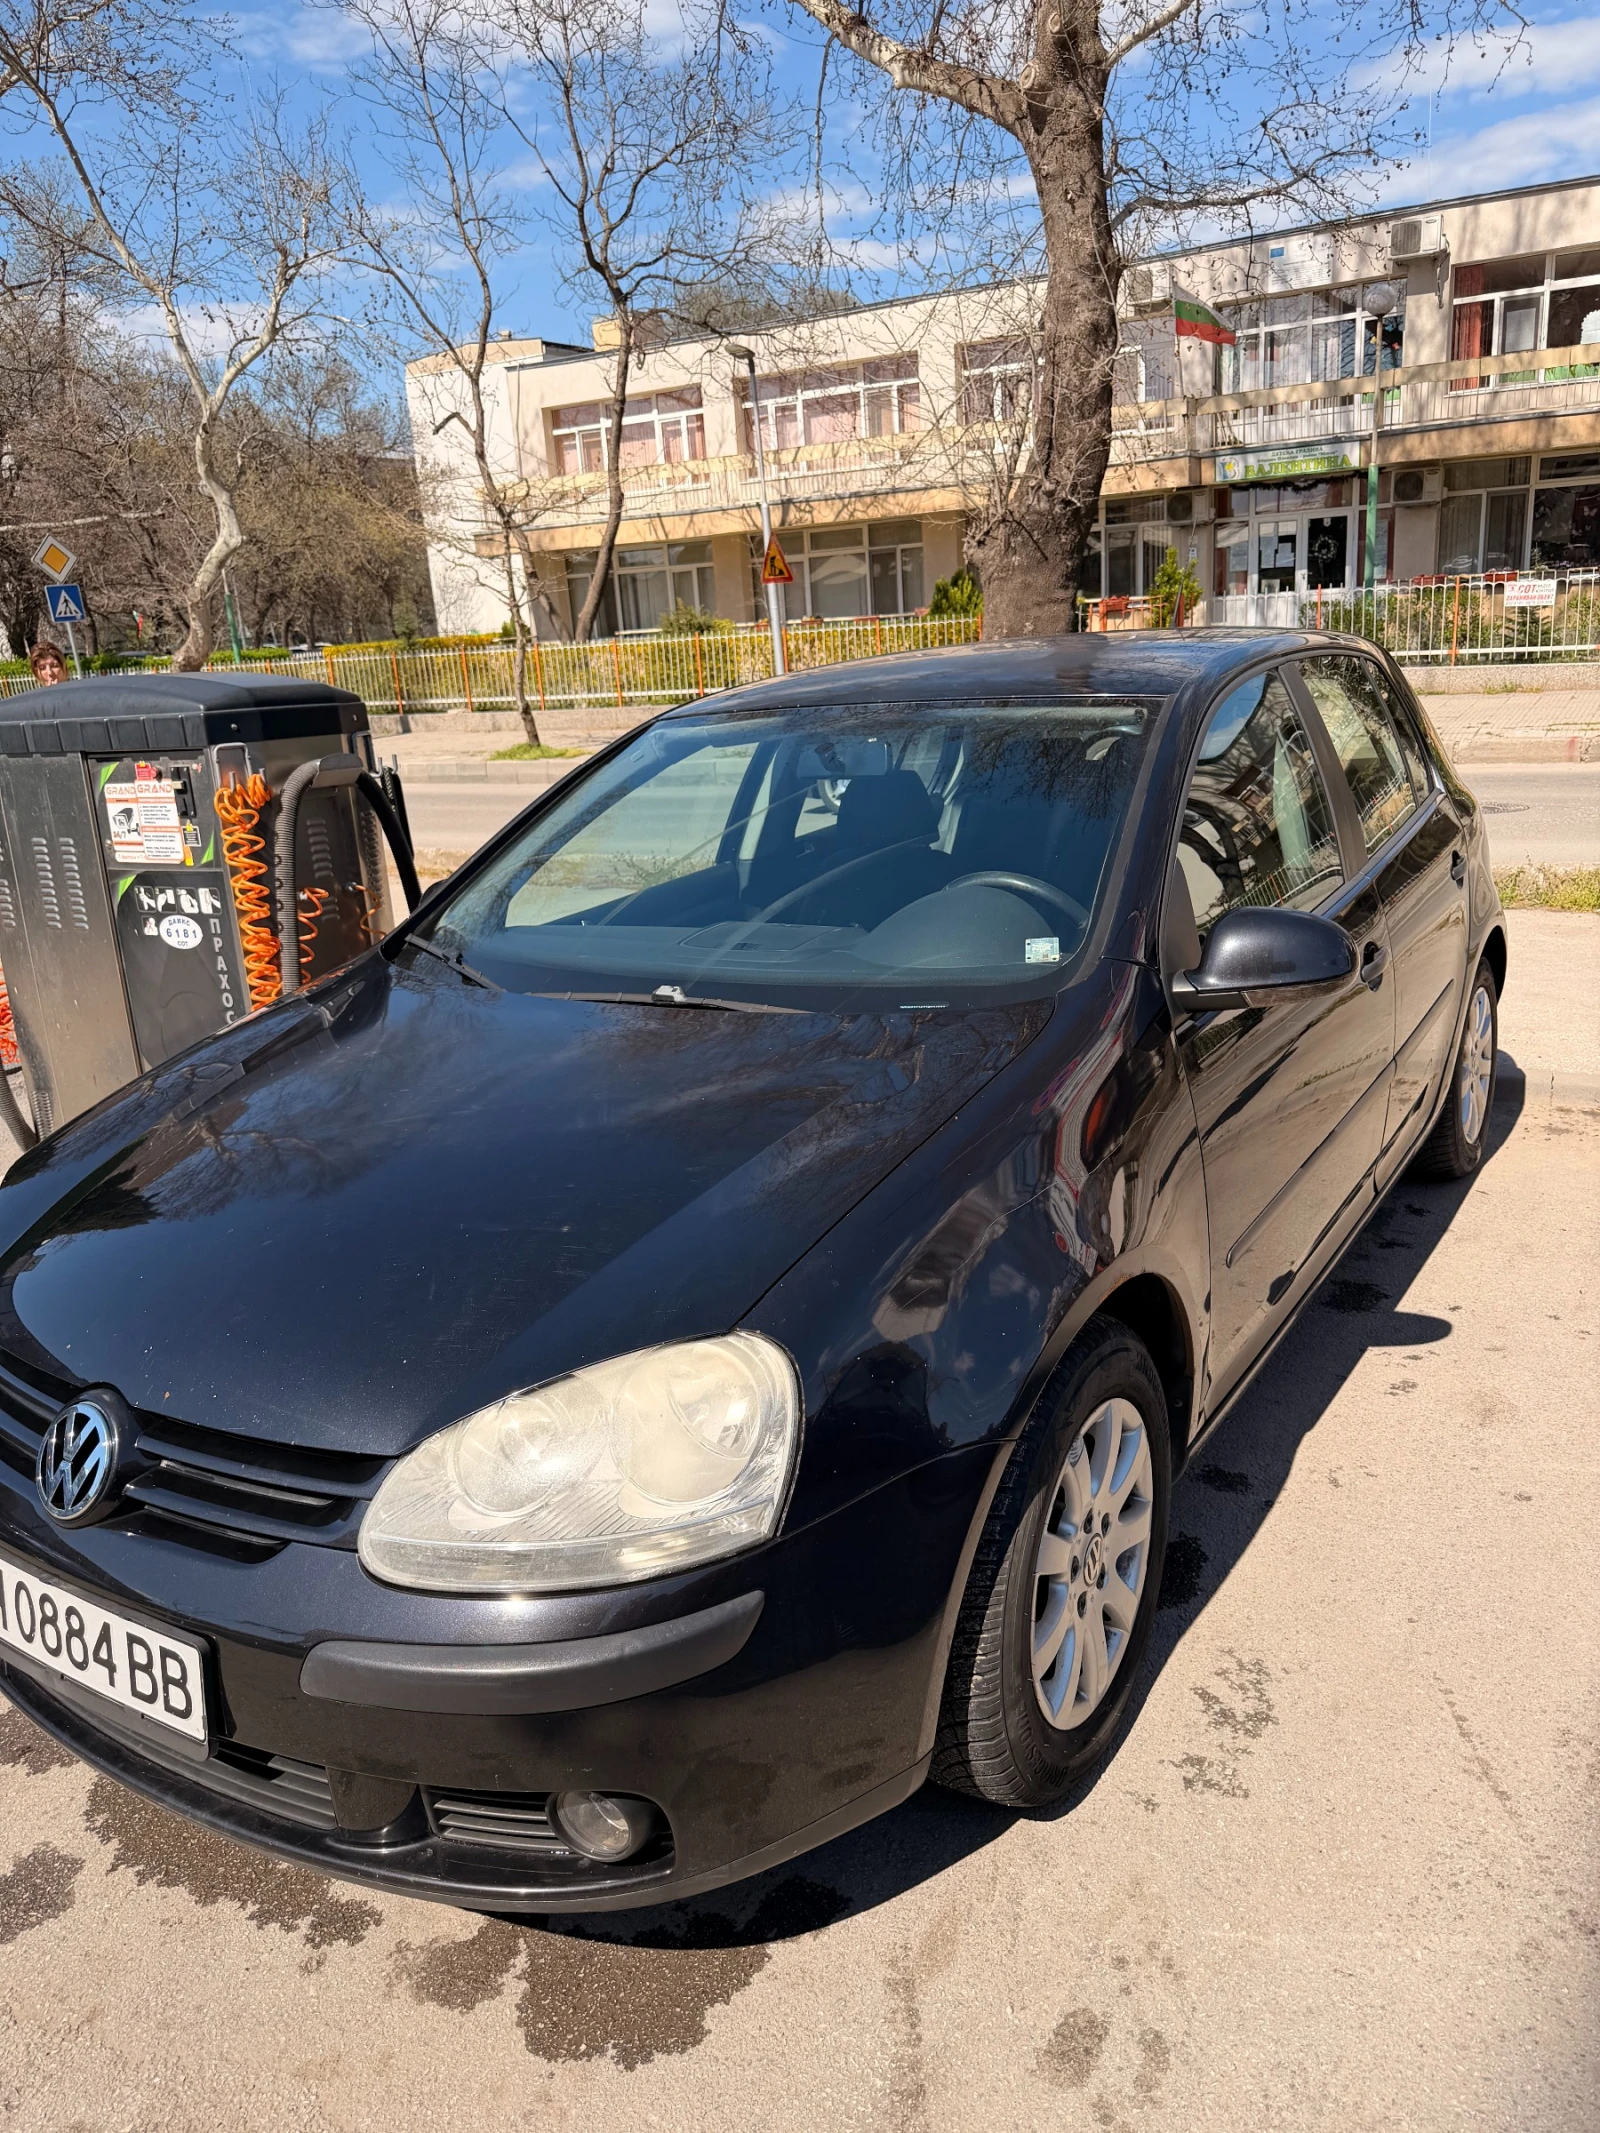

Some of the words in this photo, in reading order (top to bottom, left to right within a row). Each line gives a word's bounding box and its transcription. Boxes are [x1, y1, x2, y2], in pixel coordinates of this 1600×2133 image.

[1295, 447, 1323, 455] ГРАДИНА
[1244, 454, 1352, 477] ВАЛЕНТИНА
[1518, 584, 1536, 593] СОТ
[106, 786, 136, 795] GRAND
[137, 784, 173, 793] GRAND
[113, 831, 126, 839] 24/7
[166, 928, 197, 939] 6181
